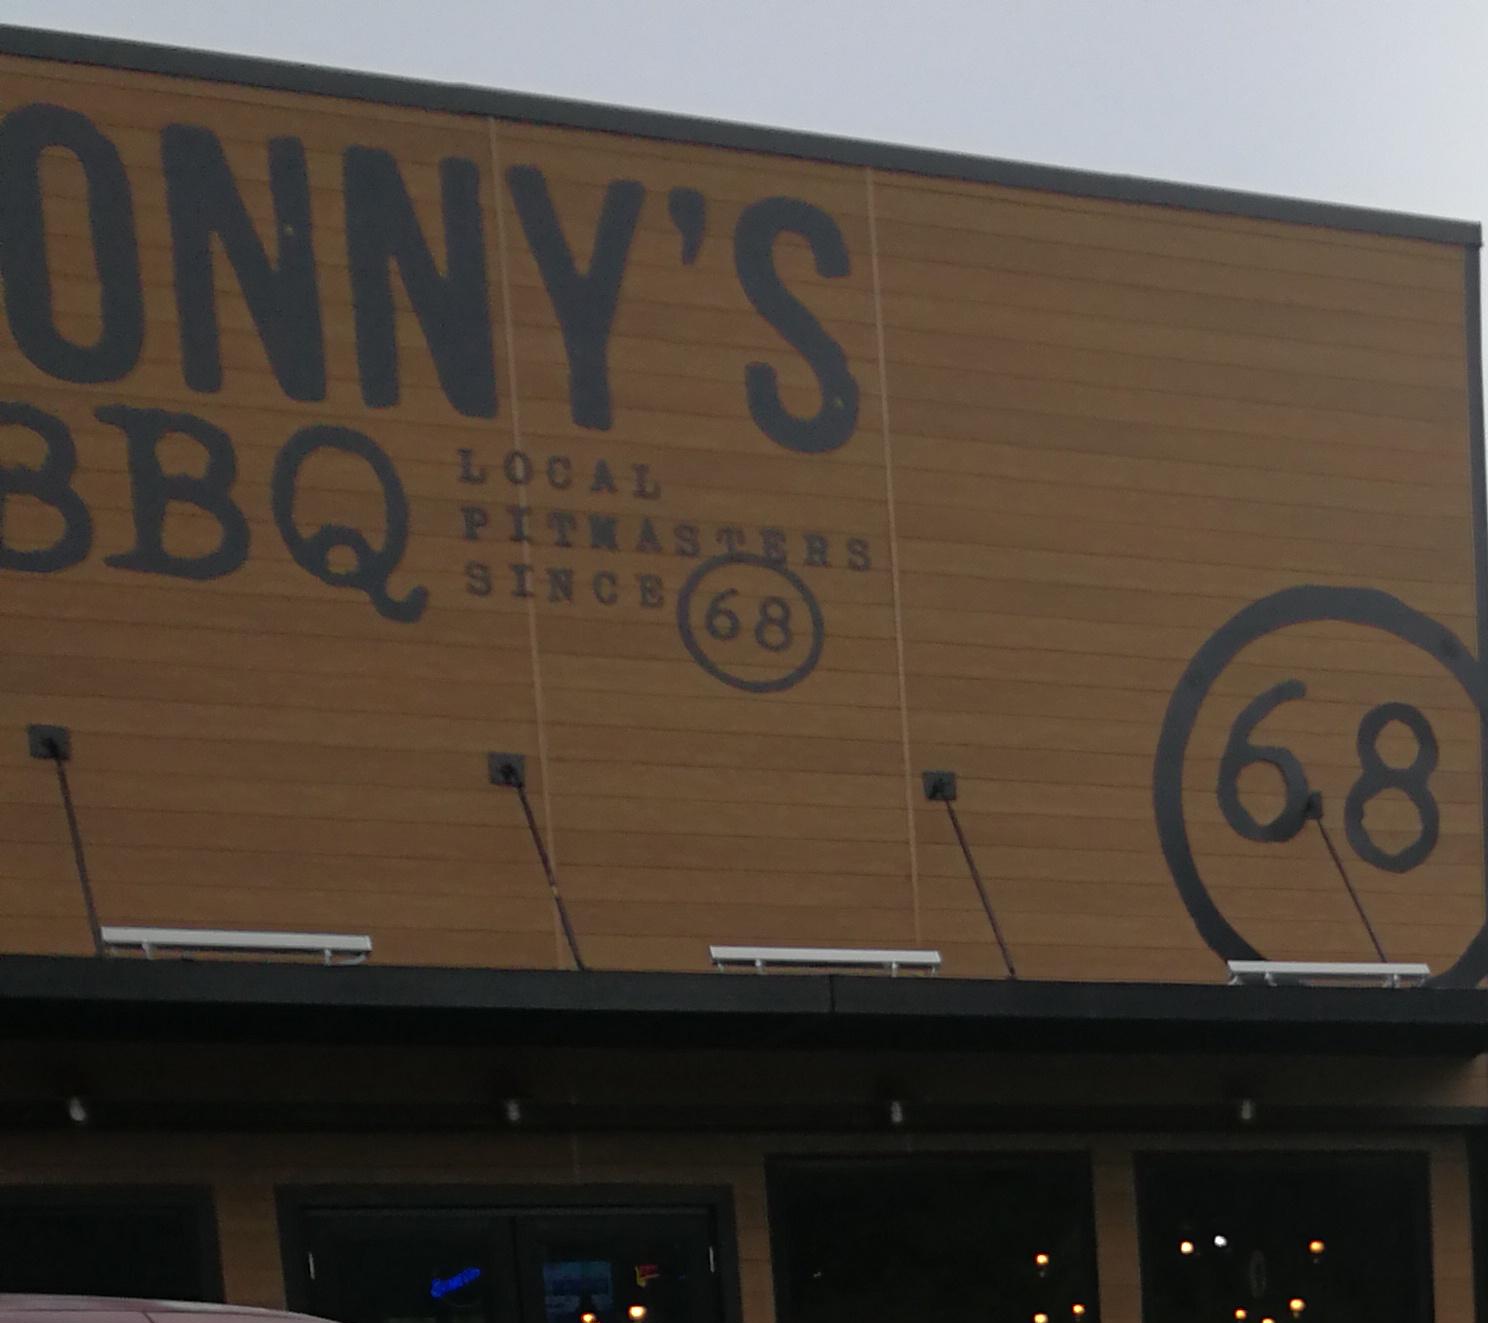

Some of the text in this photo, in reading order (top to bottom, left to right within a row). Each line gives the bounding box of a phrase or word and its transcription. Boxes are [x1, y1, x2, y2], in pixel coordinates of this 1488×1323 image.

[0, 102, 861, 454] ONNY'S
[0, 402, 430, 623] BBQ
[457, 448, 661, 500] LOCAL
[460, 506, 872, 572] PITMASTERS
[465, 560, 793, 652] SINCE 68
[1216, 678, 1440, 874] 68
